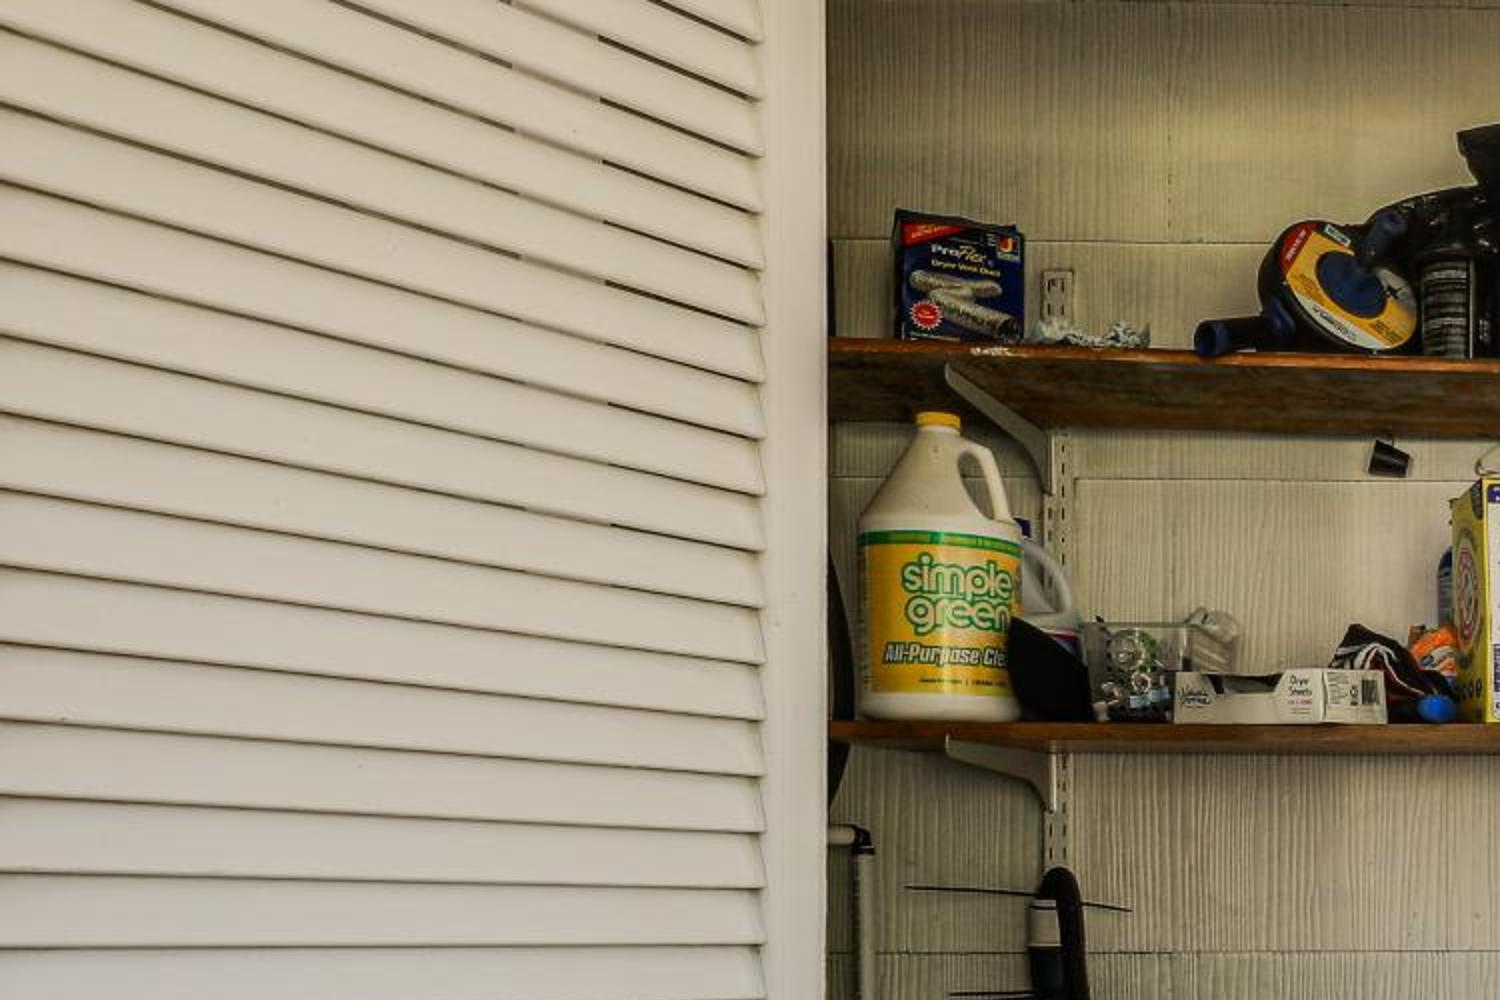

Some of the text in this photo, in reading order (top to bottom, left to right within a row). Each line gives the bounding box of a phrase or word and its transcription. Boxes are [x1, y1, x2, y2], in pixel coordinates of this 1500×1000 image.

[902, 552, 1013, 601] simple
[904, 593, 1012, 636] green
[884, 641, 980, 667] All-Purpose
